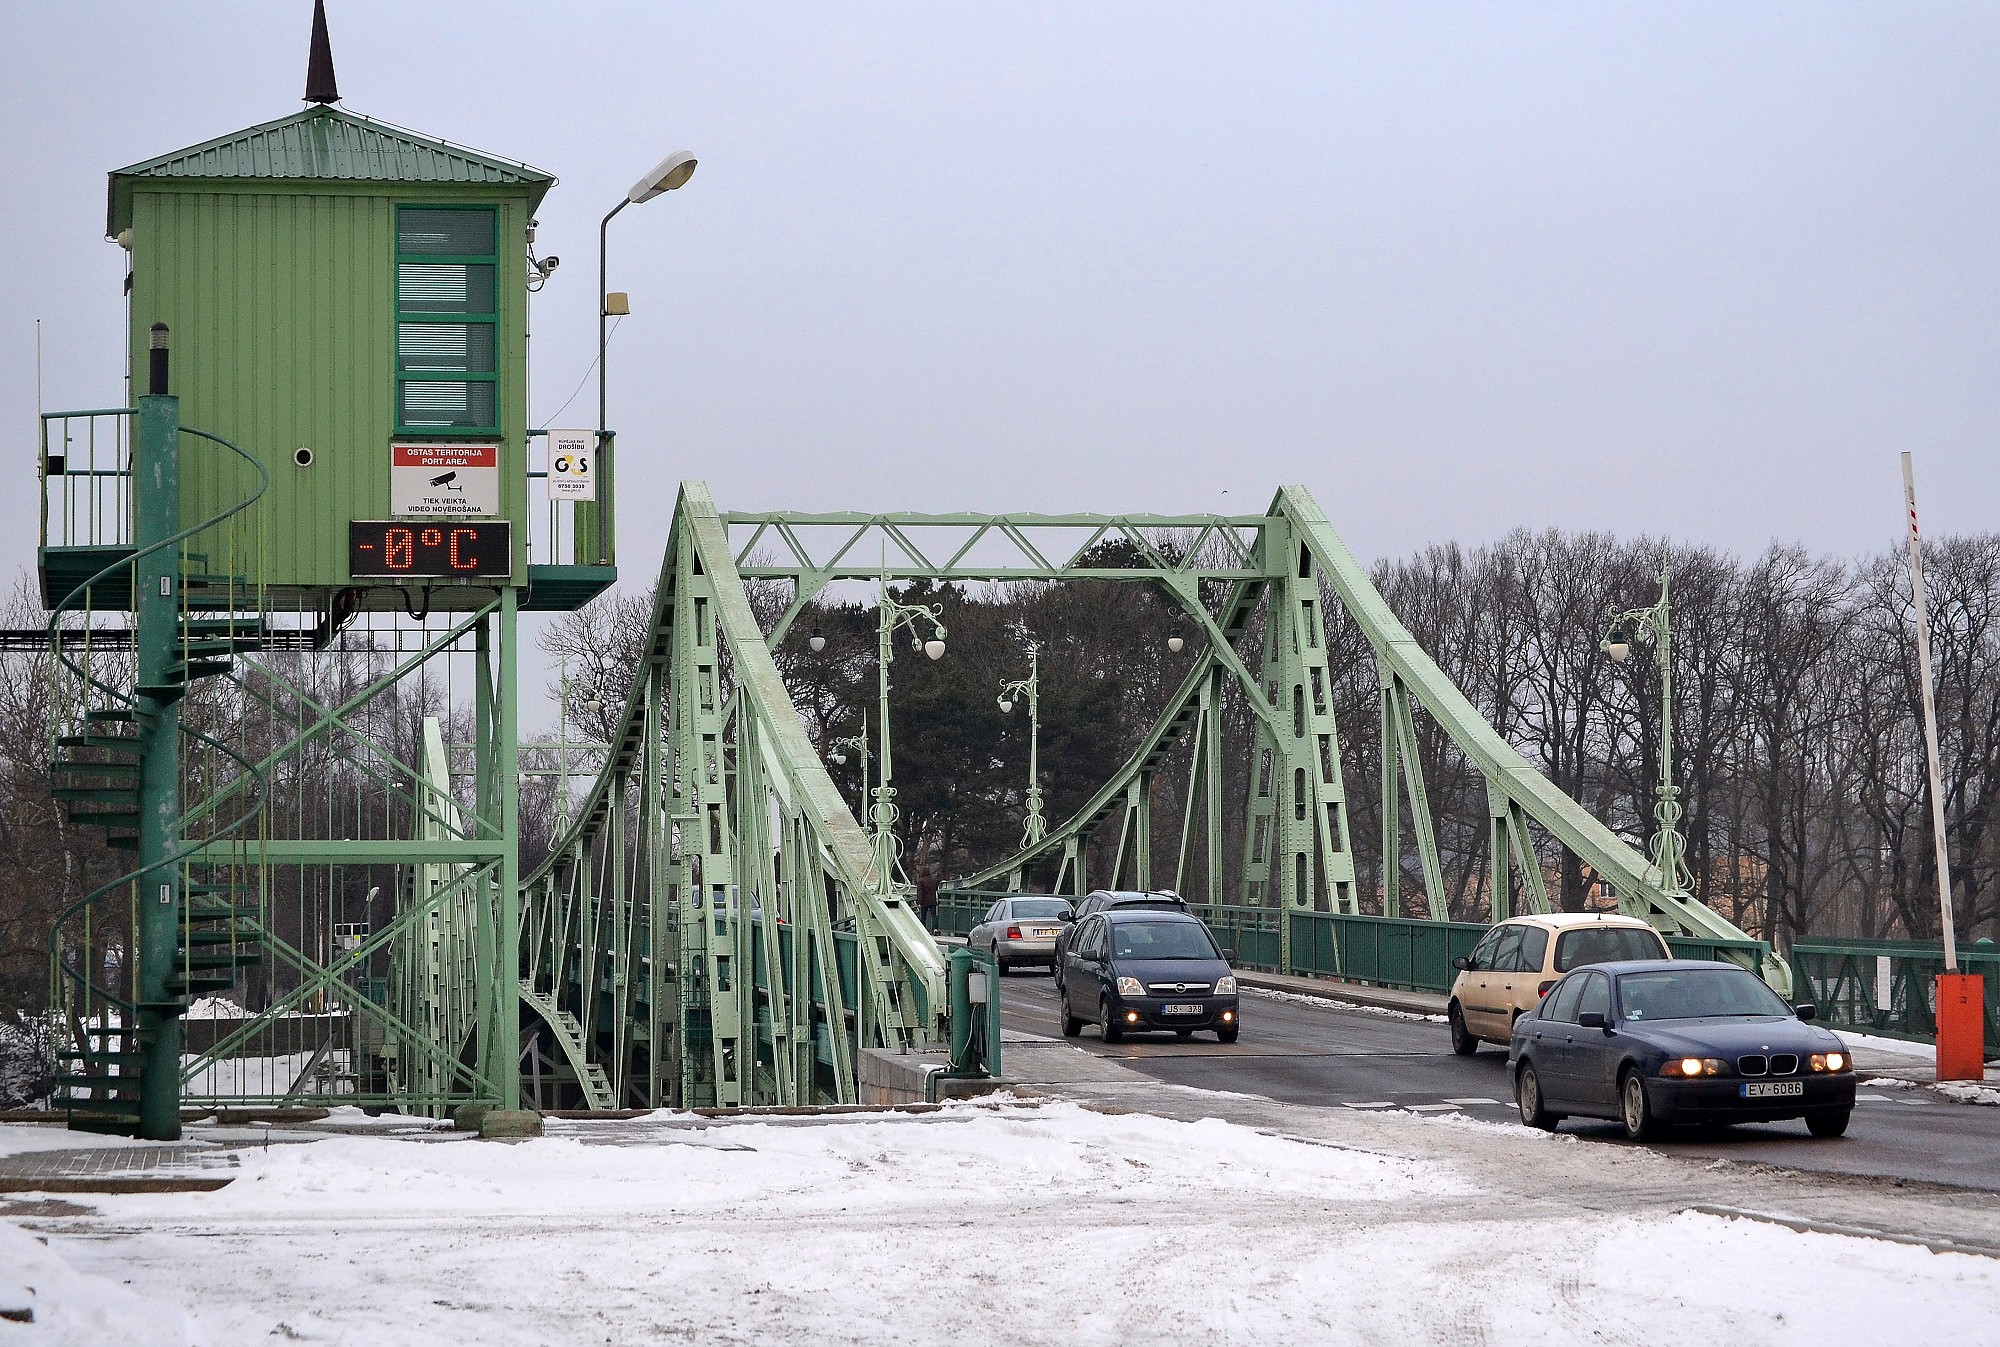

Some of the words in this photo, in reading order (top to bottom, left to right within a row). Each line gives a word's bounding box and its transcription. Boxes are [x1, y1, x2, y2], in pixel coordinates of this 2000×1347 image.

[407, 448, 433, 456] OSTAS
[435, 448, 482, 456] TERITORIJA
[407, 505, 431, 513] VIDEO
[1749, 1083, 1801, 1096] EV-6086
